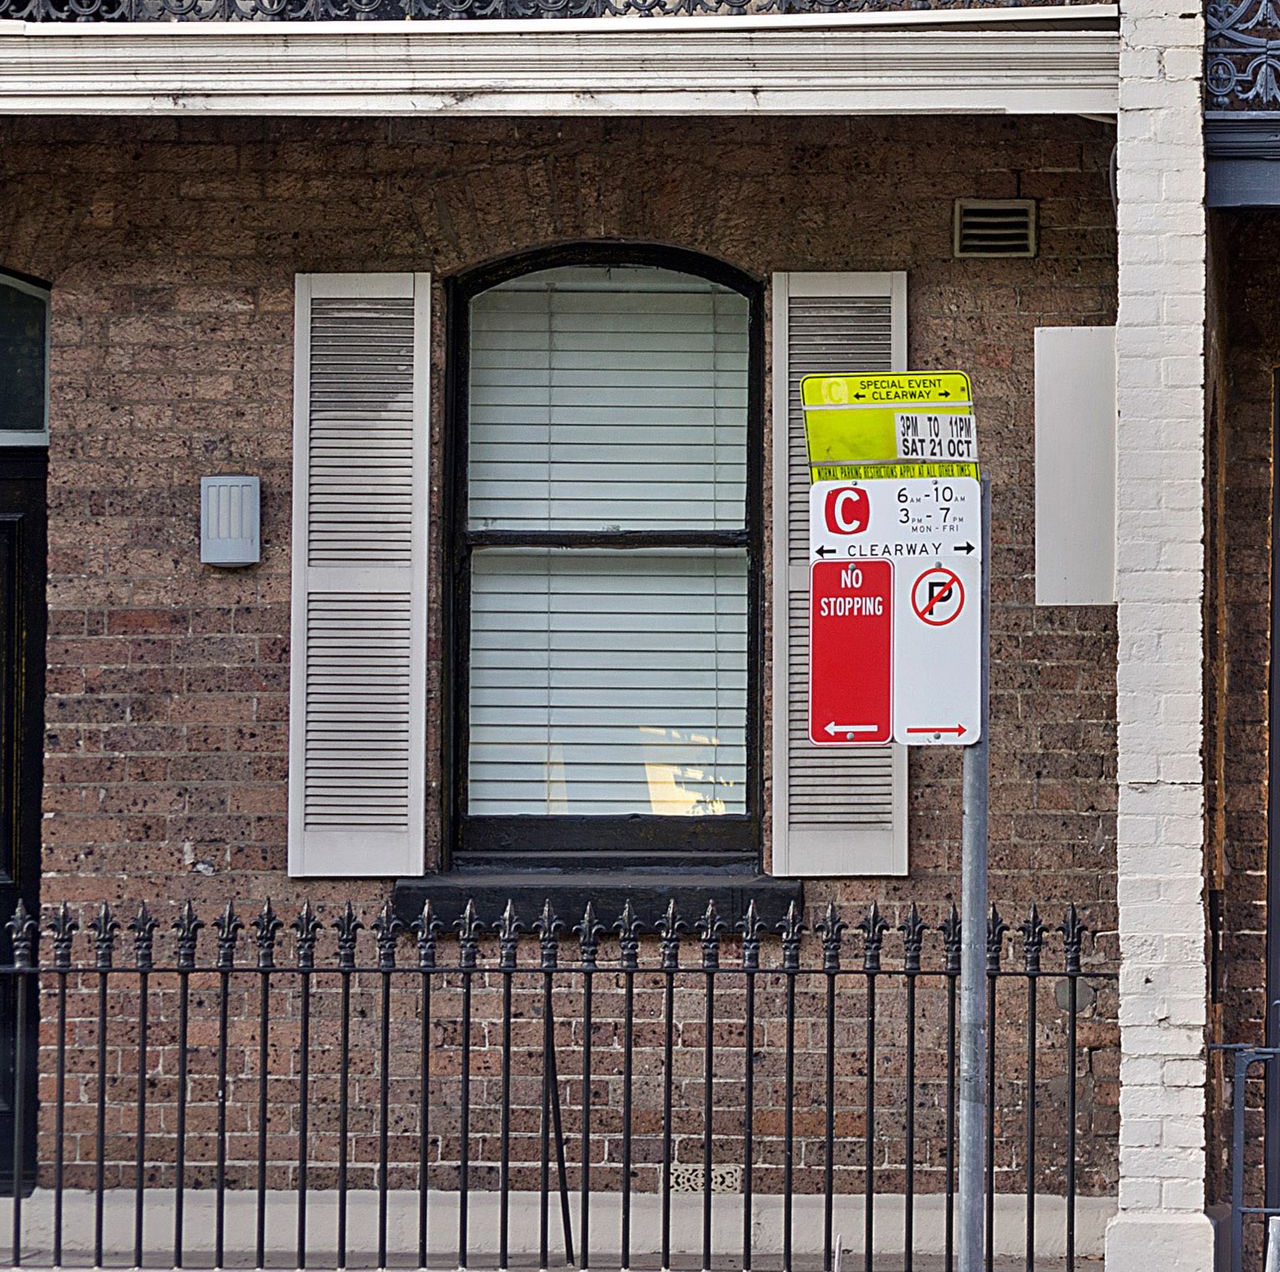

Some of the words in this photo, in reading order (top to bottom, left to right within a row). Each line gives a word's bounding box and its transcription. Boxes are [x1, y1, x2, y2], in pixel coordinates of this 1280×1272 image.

[859, 379, 904, 389] SPECIAL
[908, 378, 943, 388] EVENT
[871, 390, 931, 400] CLEARWAY
[900, 415, 919, 438] 3PM
[927, 416, 940, 438] TO
[949, 417, 972, 439] 11PM
[902, 438, 926, 457] SAT
[929, 439, 944, 457] 21
[947, 439, 972, 458] OCT
[900, 465, 915, 478] APPLY
[834, 489, 861, 533] C
[847, 542, 943, 557] CLEARWAY
[841, 569, 863, 588] NO
[820, 596, 883, 617] STOPPING
